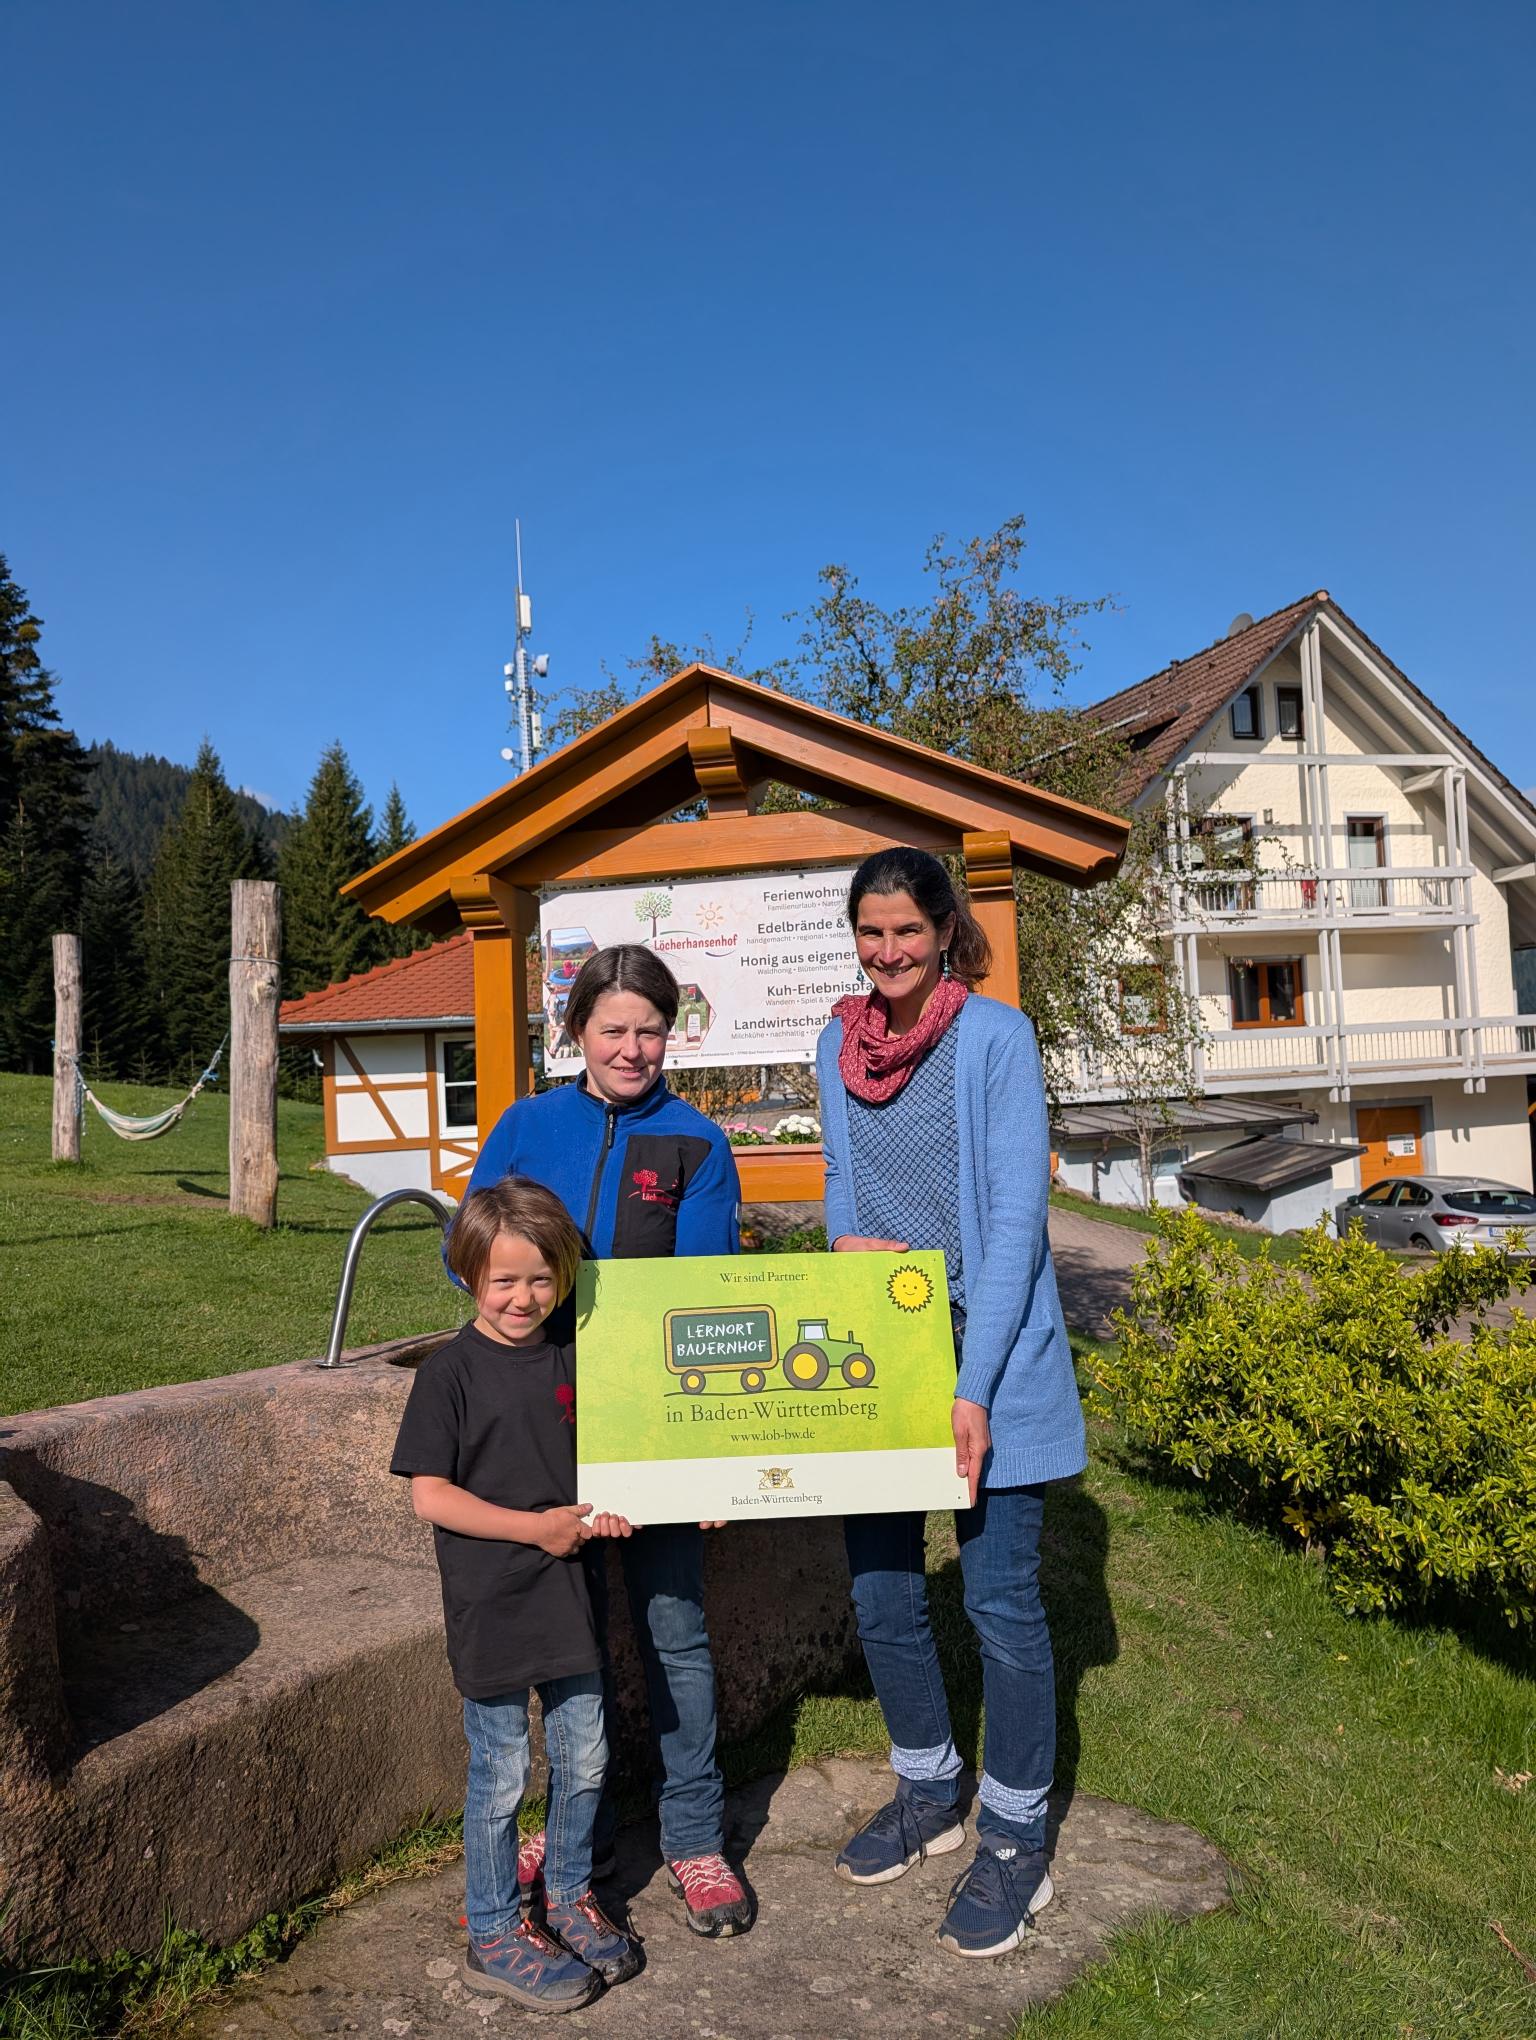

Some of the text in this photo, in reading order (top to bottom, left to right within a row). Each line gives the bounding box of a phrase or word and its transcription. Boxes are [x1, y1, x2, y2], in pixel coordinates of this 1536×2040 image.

[763, 886, 848, 903] Ferienwohnu
[767, 902, 816, 912] Familienurlaub
[757, 918, 833, 934] Edelbrände
[654, 934, 738, 951] Löcherhansenhof
[746, 935, 791, 945] handgemacht
[797, 933, 824, 942] regional
[740, 954, 779, 968] Honig
[782, 954, 804, 964] aus
[757, 966, 792, 975] Waldhonig
[797, 963, 838, 972] Blütenhonig
[765, 998, 795, 1006] Wandern
[801, 997, 818, 1005] Spiel
[731, 1030, 764, 1040] Milchkühe
[770, 1028, 804, 1038] nachhaltig
[719, 1271, 809, 1283] Wir sind Partner:
[687, 1322, 755, 1339] LERNORT
[676, 1339, 767, 1356] BAUERNHOF
[666, 1398, 878, 1423] in Baden-Württemberg
[730, 1427, 816, 1443] www.lob-bw.de
[731, 1493, 823, 1506] Baden-Württemberg
